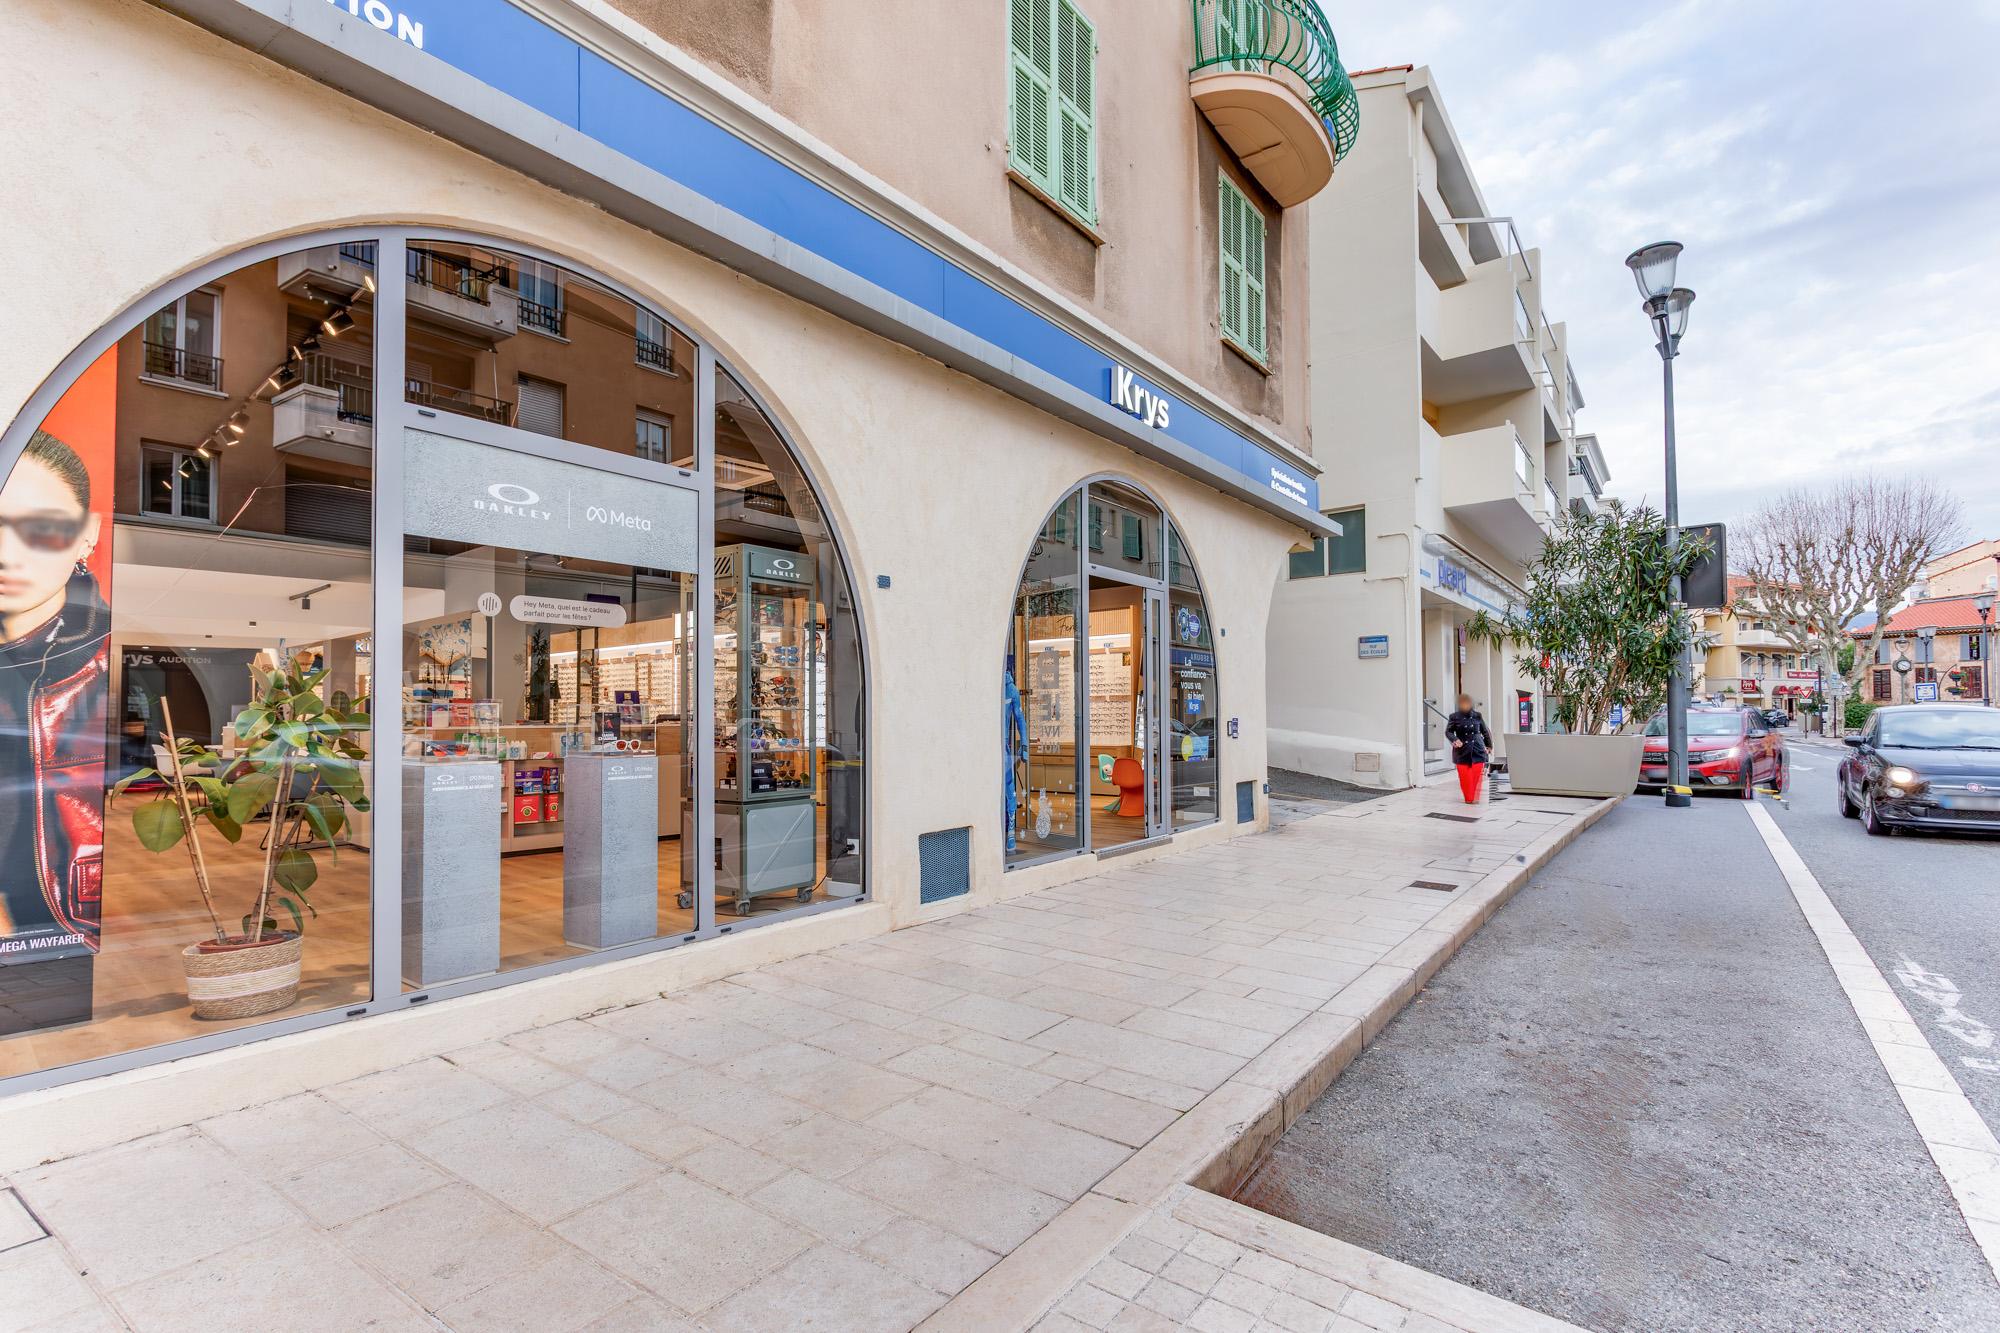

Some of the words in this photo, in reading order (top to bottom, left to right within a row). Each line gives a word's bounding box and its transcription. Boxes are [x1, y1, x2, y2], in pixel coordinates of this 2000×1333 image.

[326, 0, 424, 50] ION
[1111, 365, 1170, 428] Krys
[474, 499, 551, 521] OAKLEY
[610, 510, 651, 531] Meta
[766, 568, 801, 579] OAKLEY
[523, 601, 537, 609] Hey
[557, 604, 571, 612] quel
[582, 605, 589, 613] le
[523, 610, 545, 618] parfait
[546, 612, 561, 620] pour
[122, 653, 154, 667] rys
[158, 656, 212, 664] AUDITION
[1184, 656, 1192, 667] La
[1180, 669, 1207, 679] confiance
[1188, 701, 1200, 711] Krys
[30, 933, 85, 949] WAYFARER
